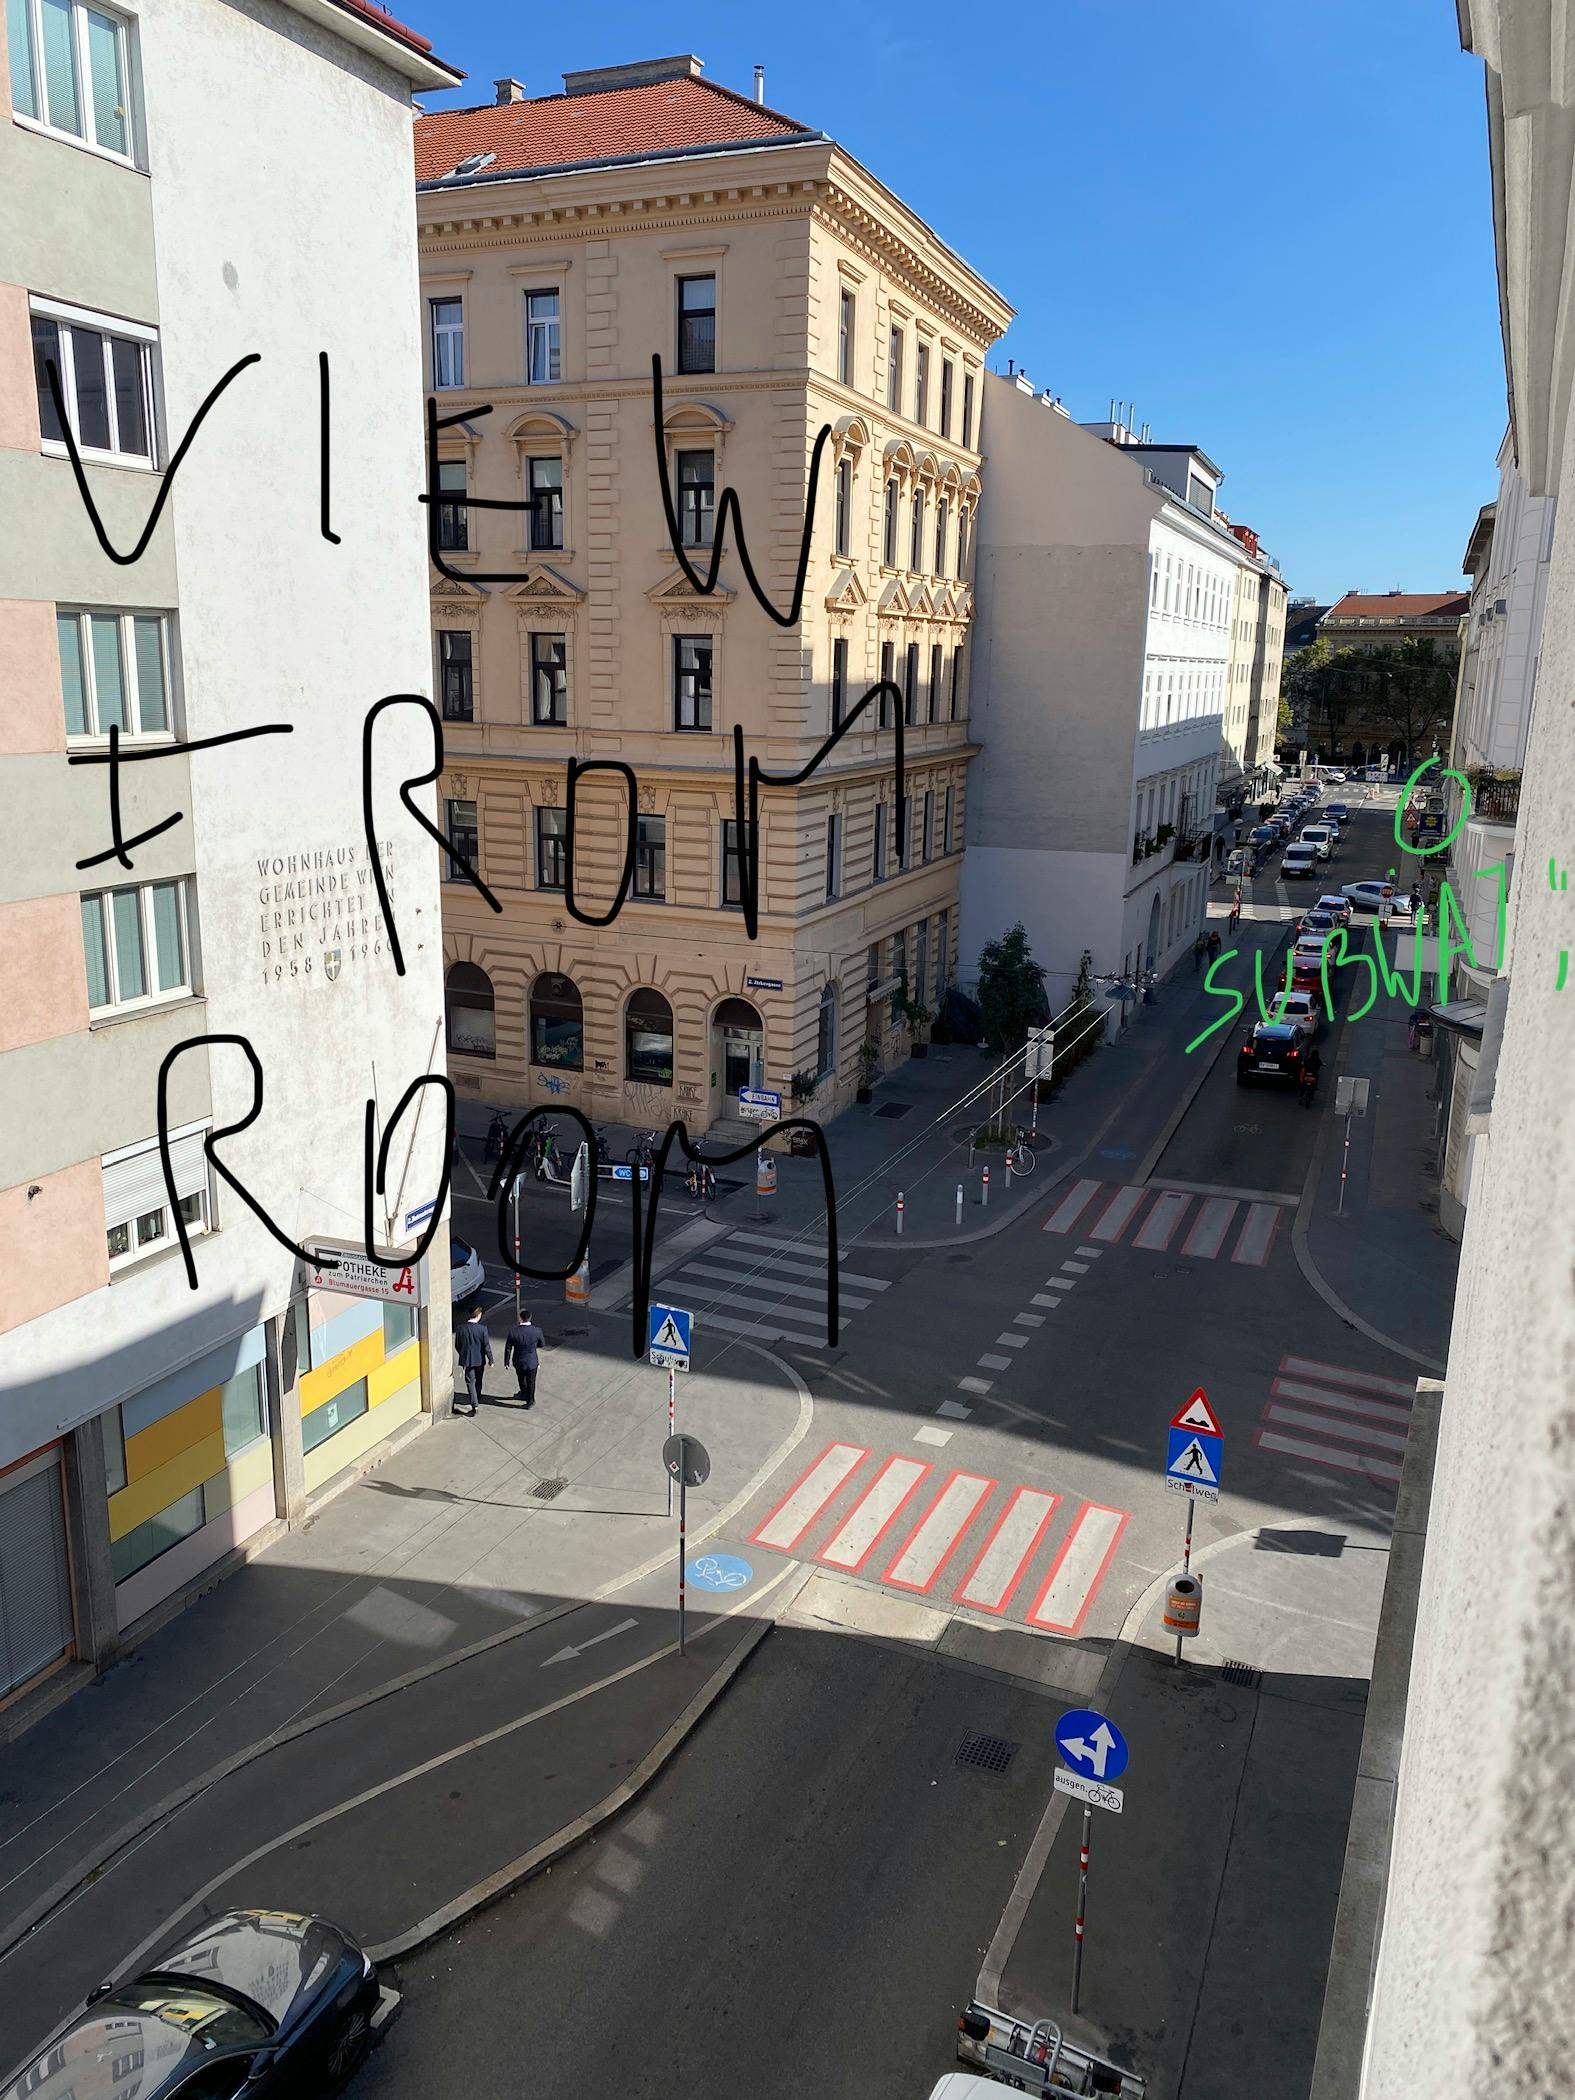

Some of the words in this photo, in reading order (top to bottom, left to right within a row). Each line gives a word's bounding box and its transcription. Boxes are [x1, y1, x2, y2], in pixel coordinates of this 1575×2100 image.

[257, 847, 354, 877] WOHNHAUS
[259, 872, 349, 905] GEMEINDE
[357, 864, 394, 885] WIN
[260, 895, 364, 933] ERRICHTET
[379, 887, 394, 907] N
[262, 932, 303, 958] DEN
[319, 911, 395, 945] JAHRE
[262, 956, 311, 984] 1958
[752, 1093, 775, 1103] EINBAHN
[619, 1169, 631, 1177] WC
[329, 1259, 387, 1278] POTHEKE
[345, 1272, 387, 1286] Patriarchen
[328, 1278, 380, 1293] Blumauergasse
[381, 1287, 389, 1295] 15
[1167, 1479, 1217, 1502] Schlweg
[1055, 1775, 1088, 1792] ausgen.
